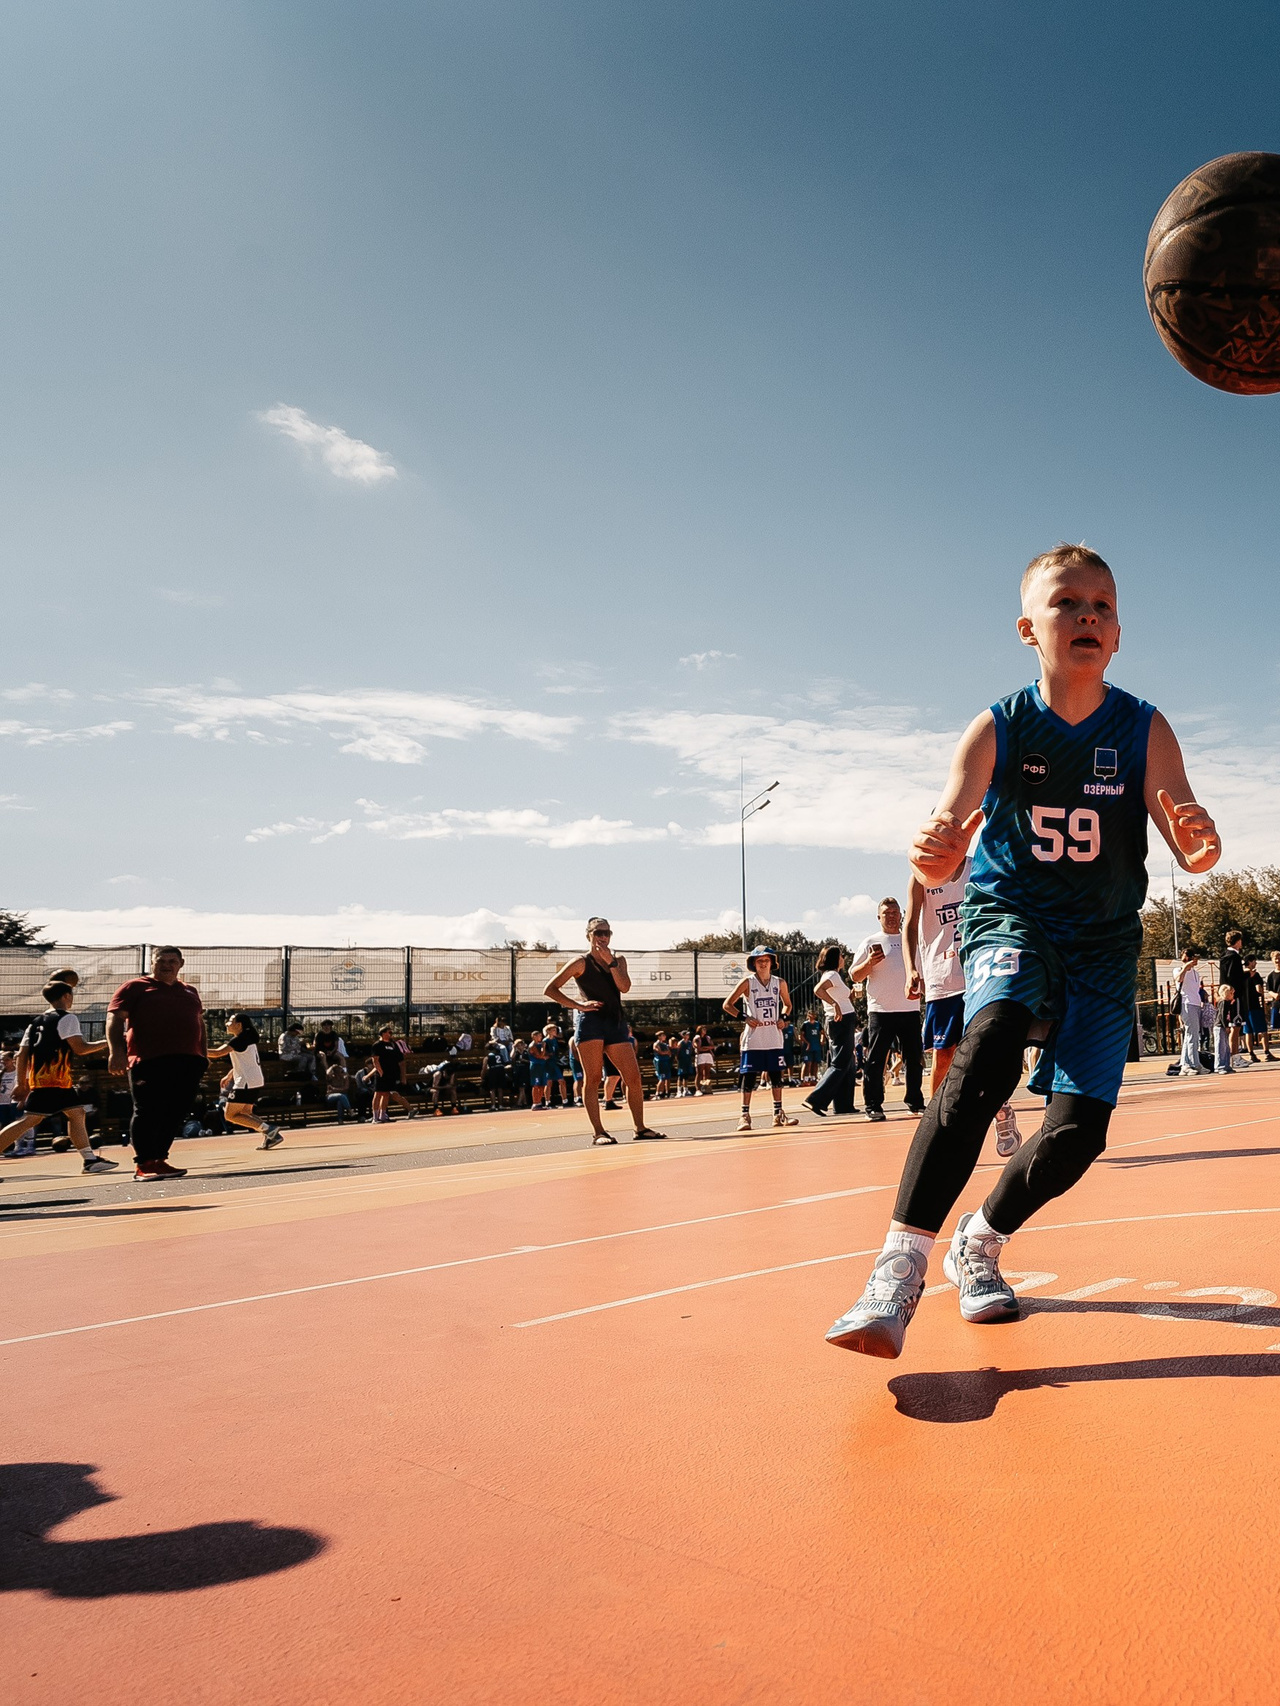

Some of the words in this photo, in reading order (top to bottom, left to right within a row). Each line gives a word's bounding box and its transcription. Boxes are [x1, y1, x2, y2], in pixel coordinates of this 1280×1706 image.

[1023, 764, 1046, 774] РФБ
[1083, 783, 1125, 795] ОЗЁРНЫЙ
[1031, 805, 1101, 862] 59
[452, 971, 489, 981] DKC
[650, 971, 672, 981] ВТБ
[763, 1009, 772, 1018] 21
